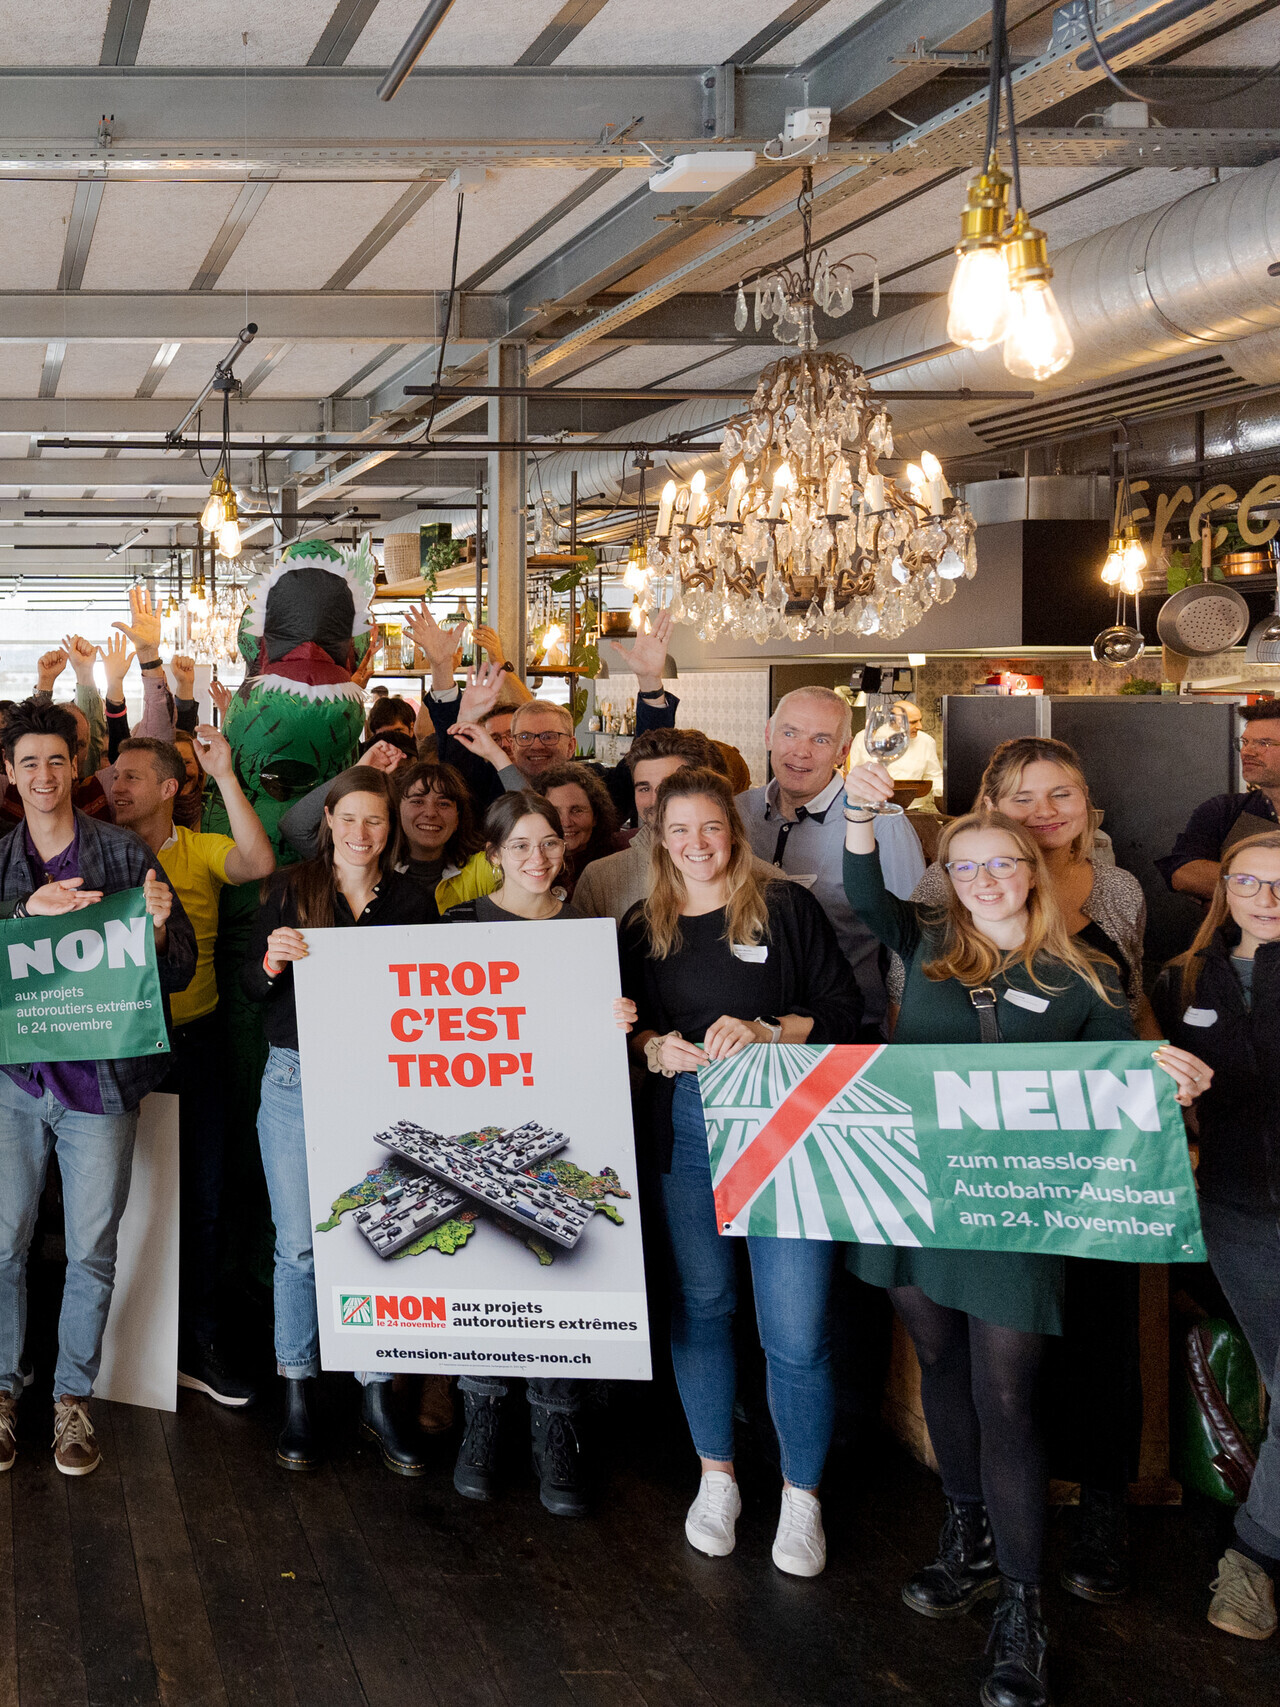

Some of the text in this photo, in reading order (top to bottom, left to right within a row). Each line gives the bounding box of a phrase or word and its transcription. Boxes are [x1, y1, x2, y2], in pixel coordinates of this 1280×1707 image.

[7, 915, 147, 980] NON
[389, 961, 519, 996] TROP
[15, 985, 85, 1003] aux projets
[16, 999, 153, 1018] autoroutiers extrêmes
[17, 1017, 113, 1035] le 24 novembre
[391, 1007, 526, 1042] C'EST
[388, 1053, 534, 1087] TROP!
[933, 1069, 1161, 1132] NEIN
[946, 1152, 1137, 1173] zum masslosen
[954, 1179, 1176, 1205] Autobahn-Ausbau
[959, 1210, 1176, 1236] am 24. November
[375, 1295, 446, 1321] NON
[452, 1302, 542, 1315] aux projets
[387, 1320, 399, 1328] 24
[400, 1321, 446, 1329] novembre
[453, 1316, 637, 1330] autoroutiers extrêmes
[376, 1348, 591, 1363] extension-autoroutes-non.ch
